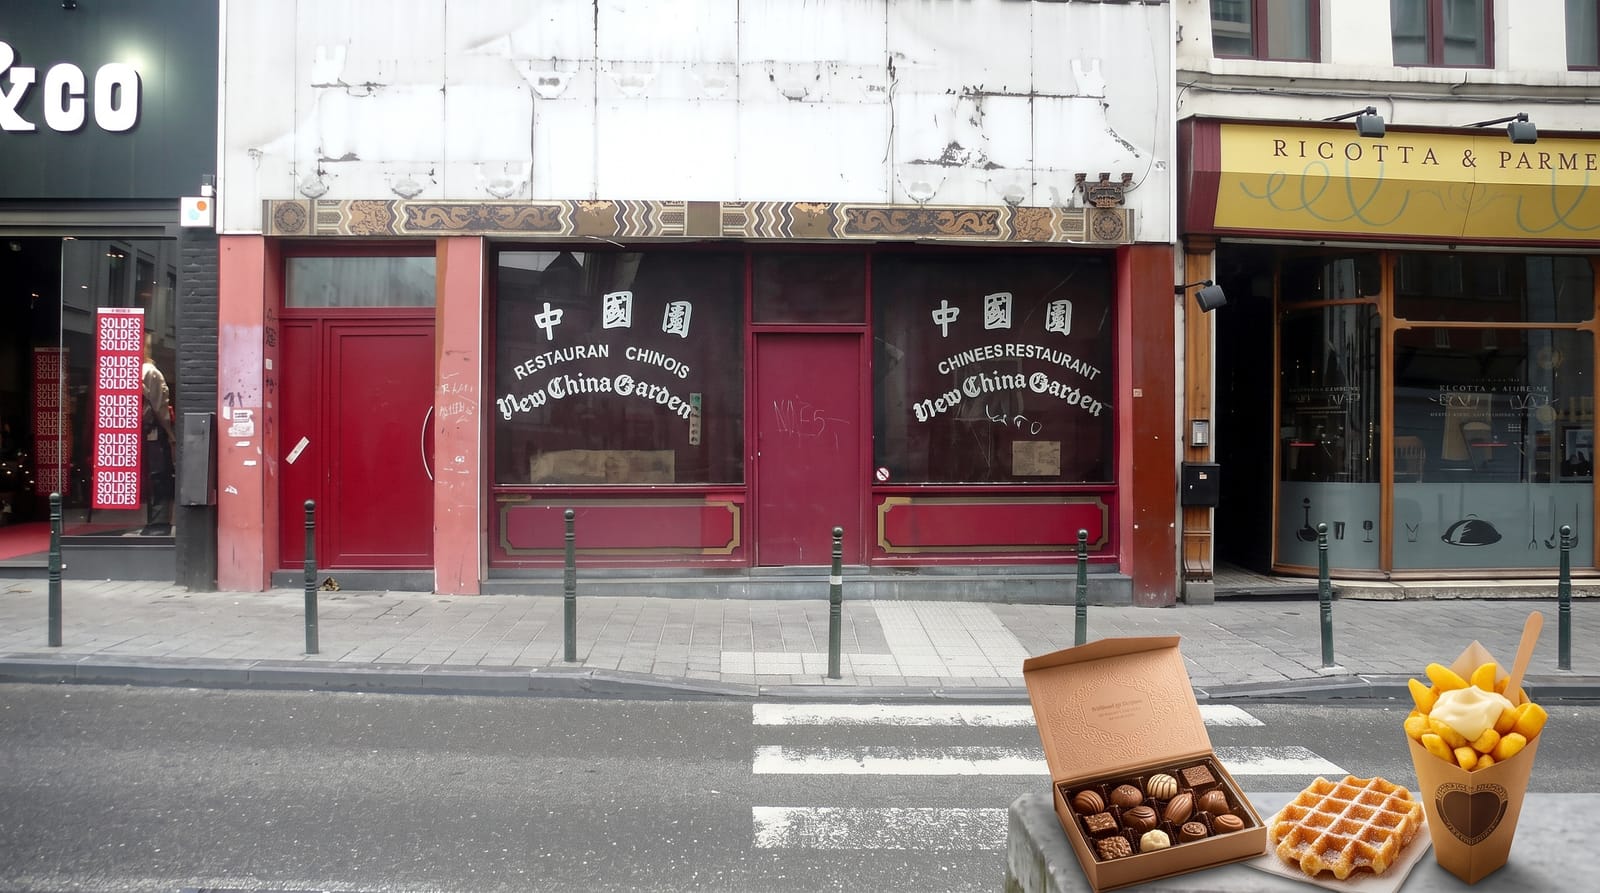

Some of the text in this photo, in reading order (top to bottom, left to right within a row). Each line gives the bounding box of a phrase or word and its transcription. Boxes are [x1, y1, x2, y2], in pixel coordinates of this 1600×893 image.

[1273, 139, 1598, 171] RICOTTA & PARME
[100, 318, 140, 328] SOLDES
[100, 328, 140, 339] SOLDES
[100, 340, 140, 350] SOLDES
[100, 356, 139, 367] SOLDES
[513, 344, 690, 380] RESTAURAN CHINOIS
[938, 344, 1102, 381] CHINEES RESTAURANT
[99, 368, 139, 378] SOLDES
[99, 378, 139, 389] SOLDES
[99, 396, 138, 406] SOLDES
[496, 388, 547, 421] New
[547, 372, 613, 399] China
[613, 374, 692, 420] Garden
[912, 388, 962, 422] New
[962, 370, 1026, 398] China
[1028, 372, 1103, 417] Garden
[98, 406, 138, 417] SOLDES
[98, 418, 138, 428] SOLDES
[98, 434, 138, 444] SOLDES
[98, 444, 137, 455] SOLDES
[97, 456, 137, 466] SOLDES
[97, 472, 136, 482] SOLDES
[97, 482, 136, 493] SOLDES
[96, 494, 136, 504] SOLDES
